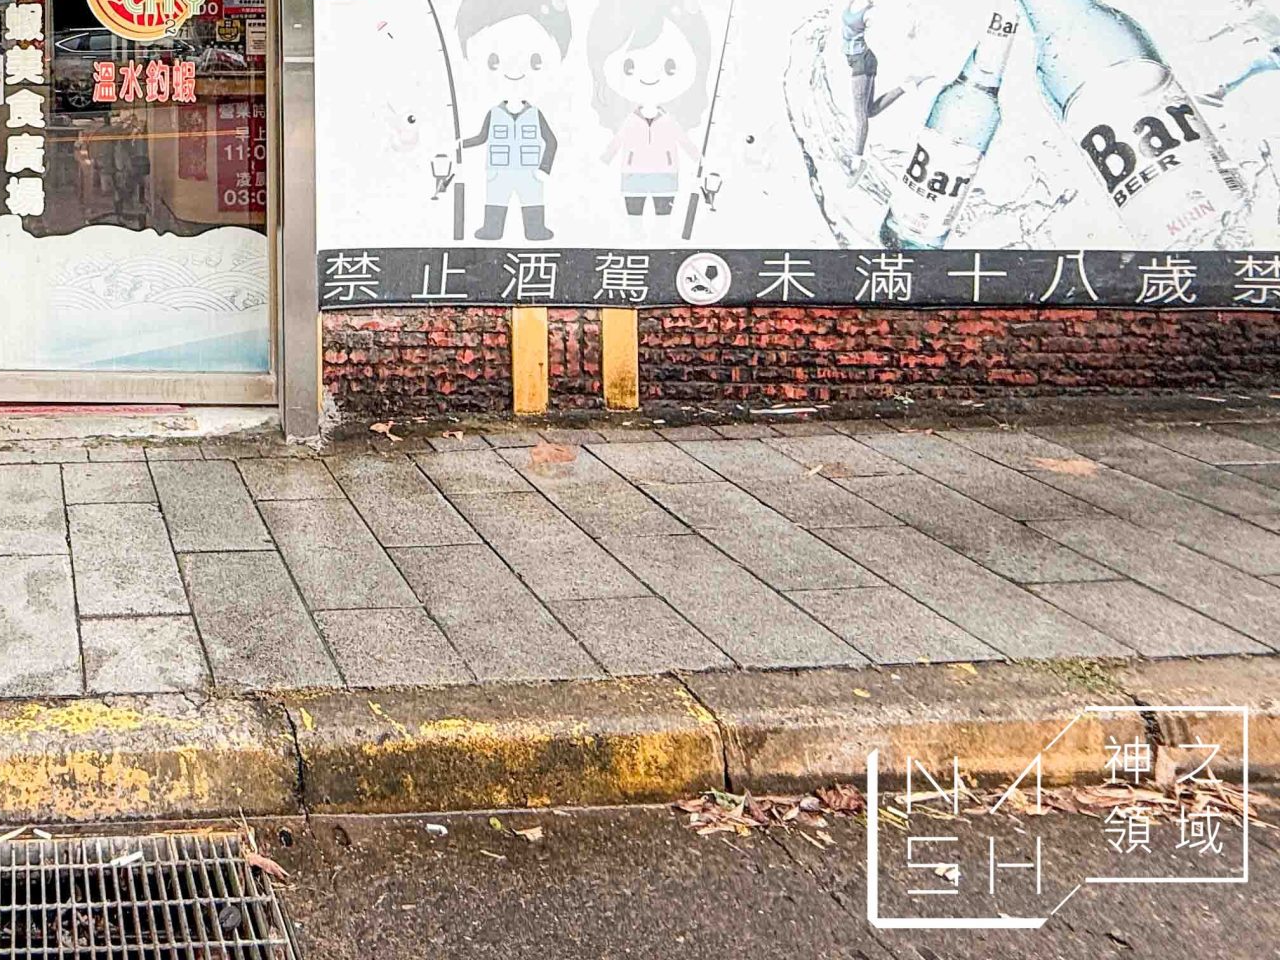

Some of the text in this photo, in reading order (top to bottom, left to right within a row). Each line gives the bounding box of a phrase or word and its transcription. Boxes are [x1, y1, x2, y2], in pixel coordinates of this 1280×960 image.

[93, 60, 197, 103] 溫水釣蝦
[906, 142, 971, 198] Bar
[1081, 104, 1201, 194] Bar
[902, 175, 939, 203] BEER
[1113, 154, 1182, 208] BEER
[323, 251, 649, 302] 禁止酒駕
